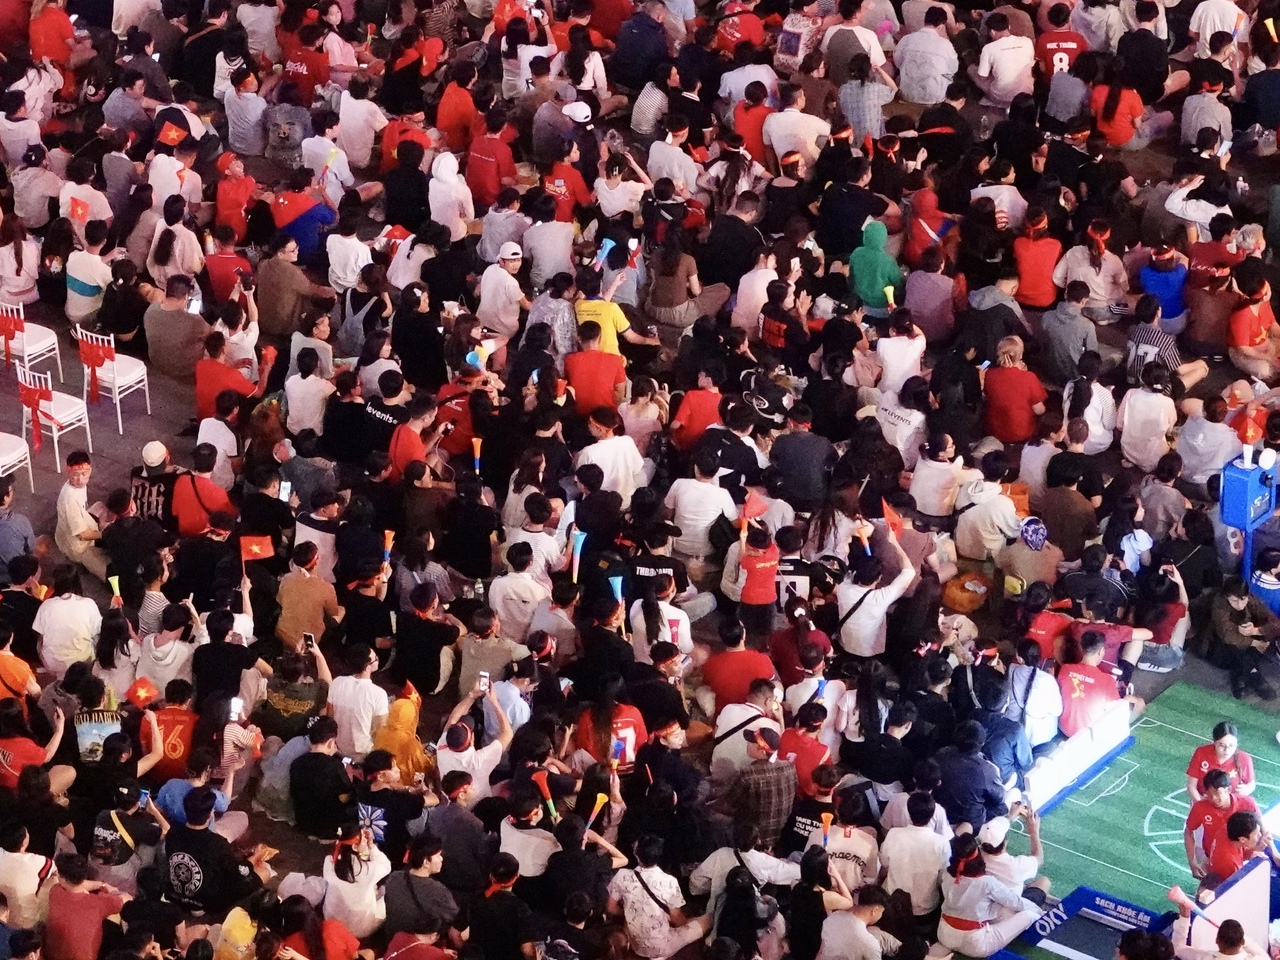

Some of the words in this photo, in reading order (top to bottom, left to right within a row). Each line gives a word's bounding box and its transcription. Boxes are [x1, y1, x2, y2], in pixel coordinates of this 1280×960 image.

[1053, 51, 1070, 74] 8
[887, 410, 912, 427] LEVENTS
[73, 712, 91, 727] BAD
[91, 710, 122, 725] HABITS
[1034, 902, 1069, 937] OXY
